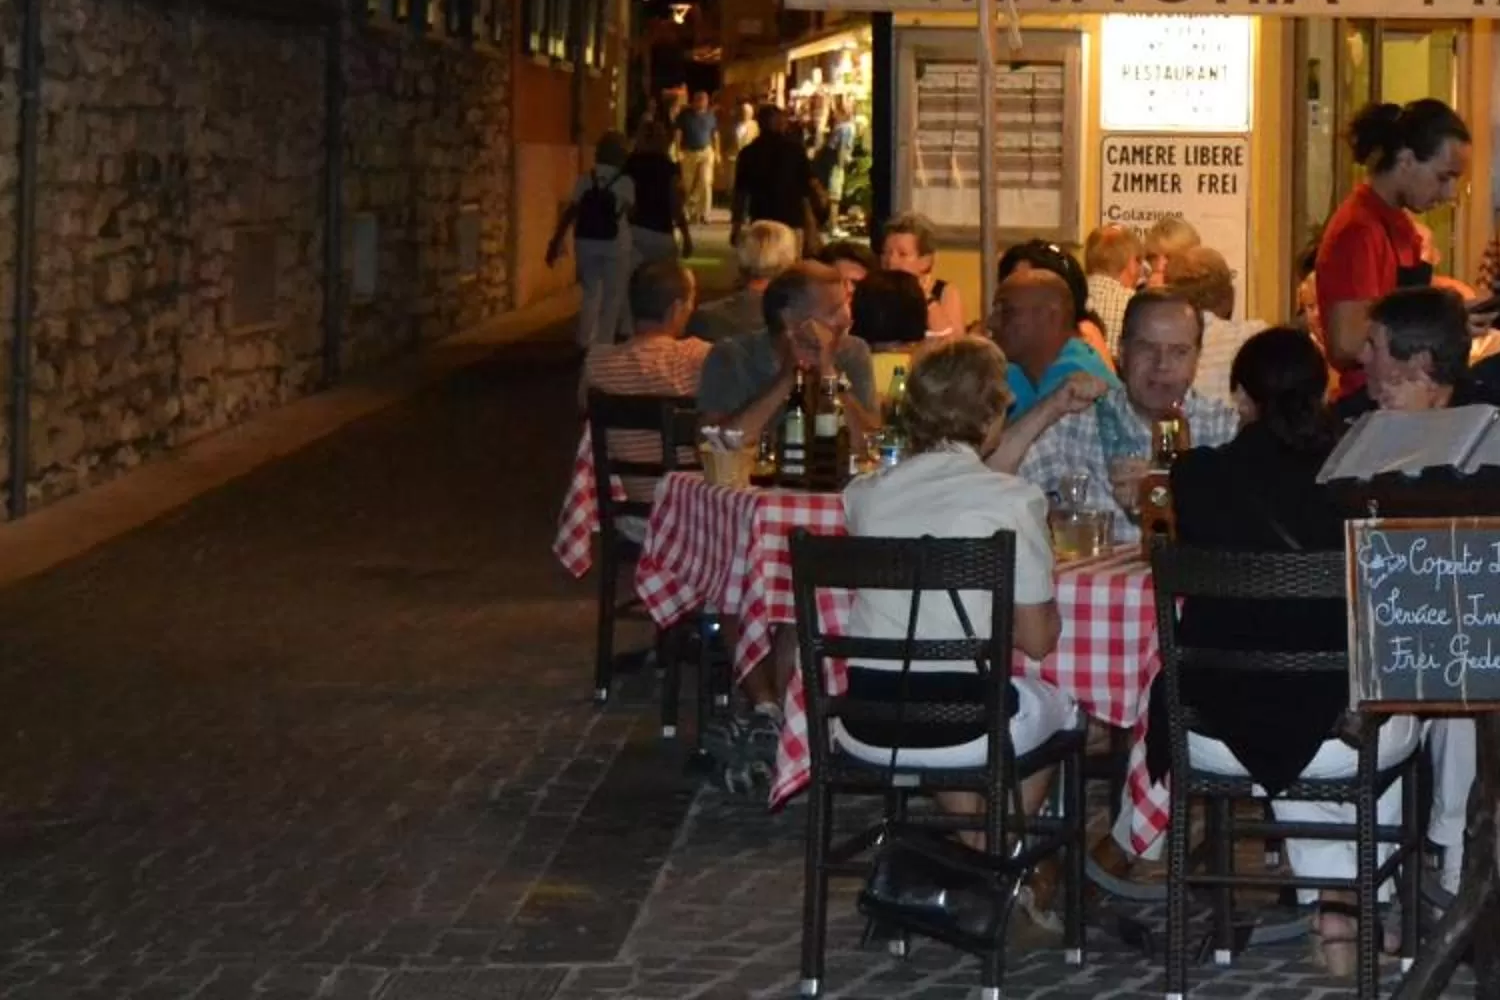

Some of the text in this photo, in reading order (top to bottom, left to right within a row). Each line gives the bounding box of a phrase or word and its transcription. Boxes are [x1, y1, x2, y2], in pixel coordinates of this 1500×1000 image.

[1106, 144, 1244, 167] CAMERE LIBERE
[1111, 172, 1237, 195] ZIMMER FREI
[1382, 636, 1441, 673] Frei
